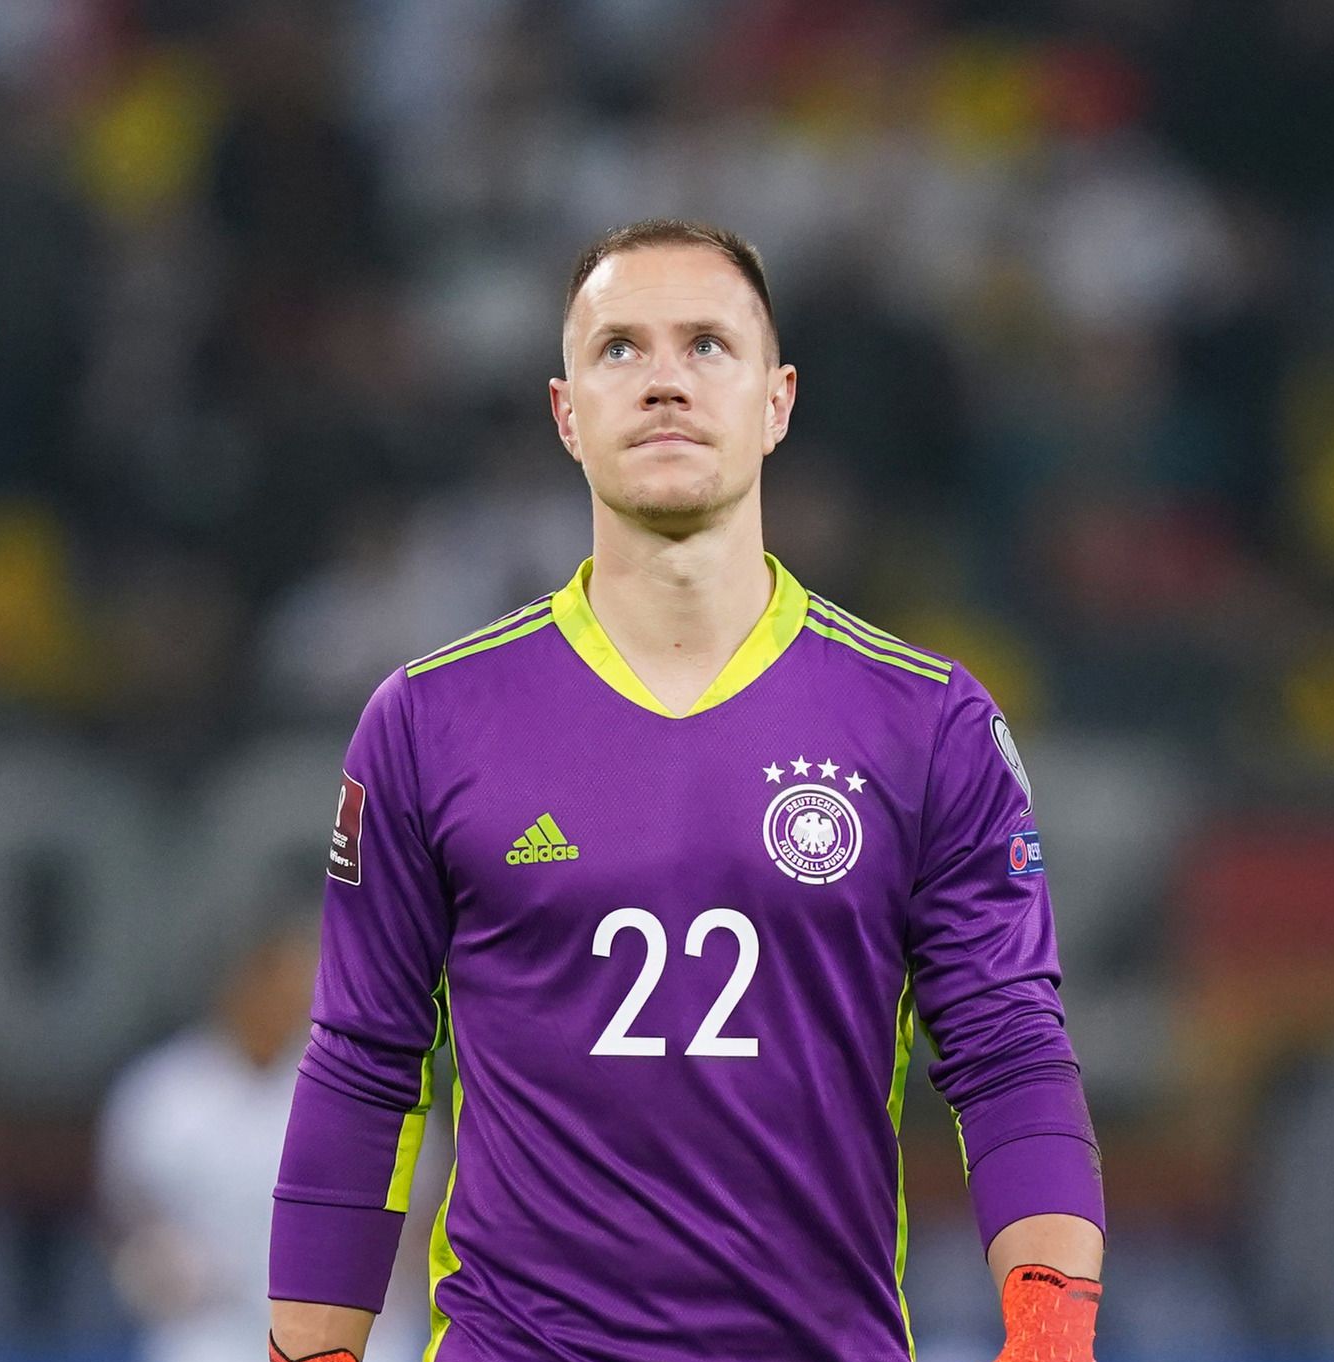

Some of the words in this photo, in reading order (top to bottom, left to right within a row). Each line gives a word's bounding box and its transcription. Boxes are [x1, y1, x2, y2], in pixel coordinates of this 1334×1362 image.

[785, 796, 842, 818] DEUTSCHER
[506, 845, 579, 865] adidas
[779, 839, 846, 870] FUSSBALL-BUND
[589, 907, 760, 1056] 22
